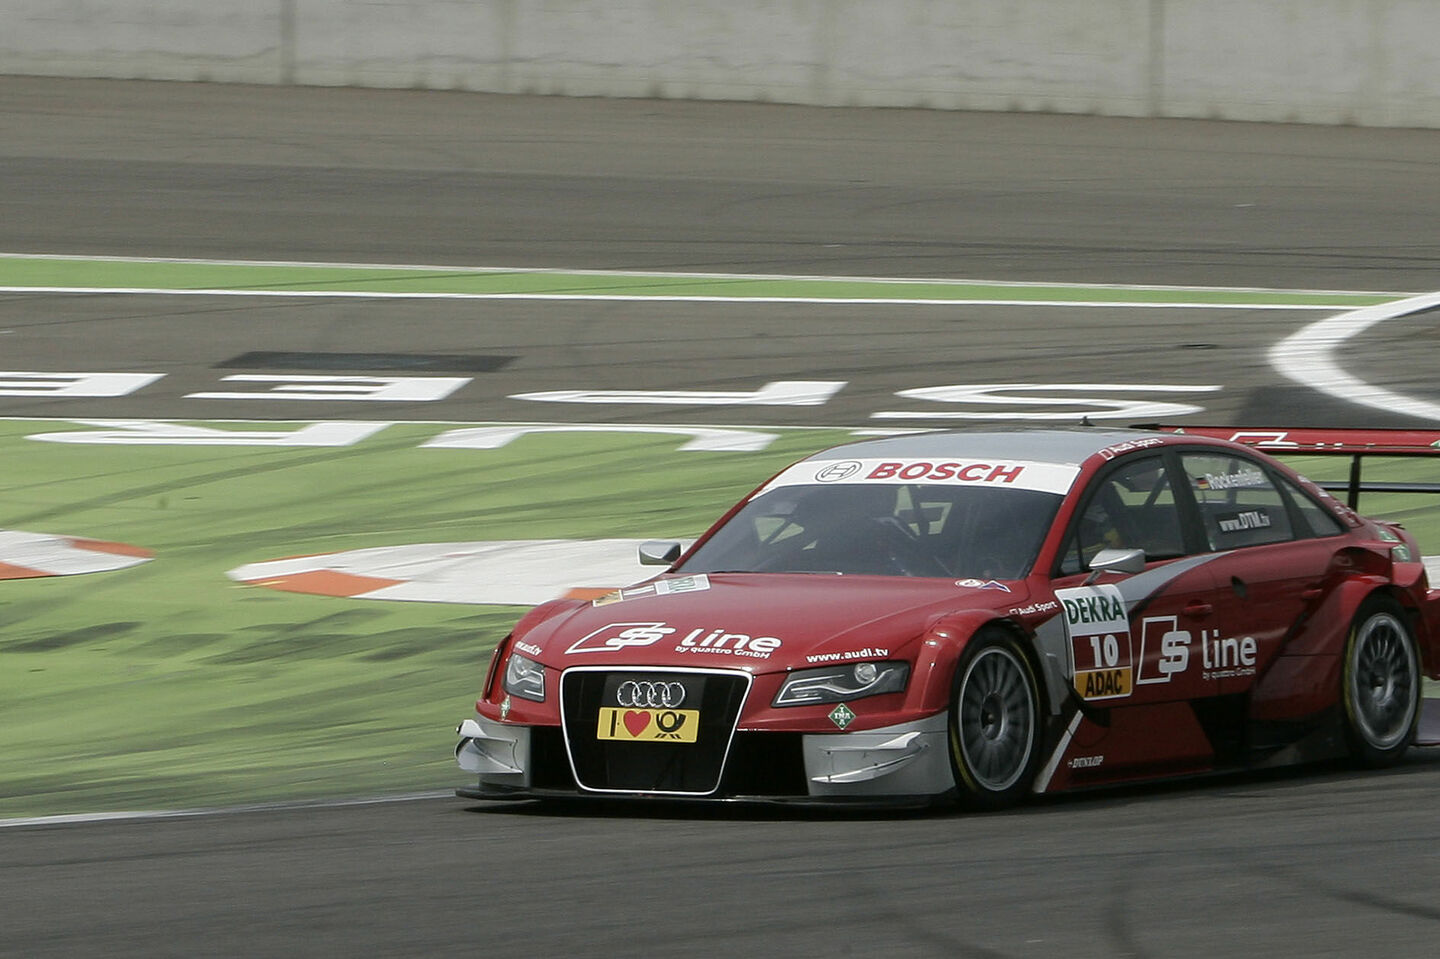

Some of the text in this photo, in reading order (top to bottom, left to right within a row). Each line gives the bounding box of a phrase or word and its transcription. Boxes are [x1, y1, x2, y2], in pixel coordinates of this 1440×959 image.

[865, 462, 1025, 483] BOSCH
[1018, 601, 1058, 615] Audi Sport
[1063, 595, 1126, 625] DEKRA
[681, 628, 782, 653] line
[1090, 634, 1119, 668] 10
[1201, 629, 1258, 669] line
[690, 646, 732, 655] quattro
[734, 649, 770, 659] GmbH
[806, 648, 889, 663] www.audi.tv
[1085, 670, 1122, 697] ADAC
[1072, 755, 1104, 768] DUNLOP
